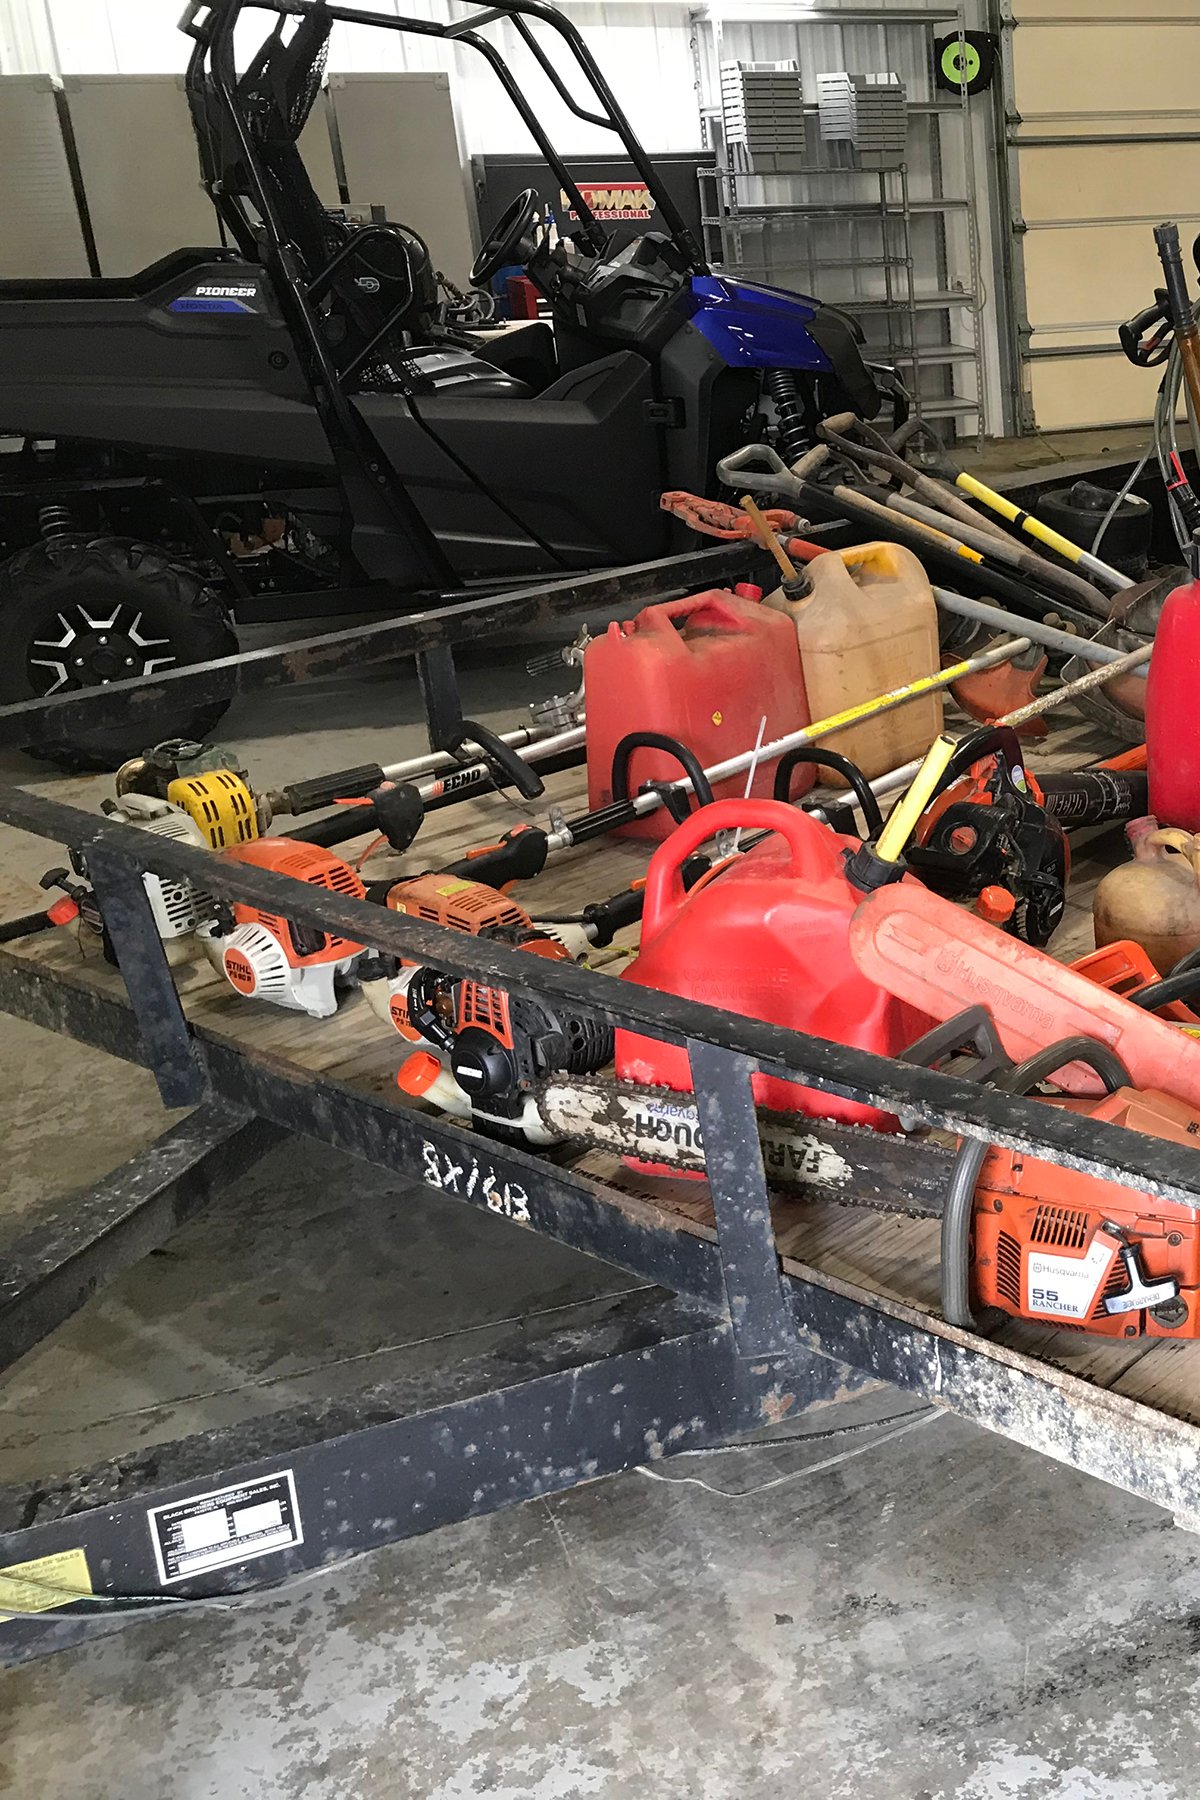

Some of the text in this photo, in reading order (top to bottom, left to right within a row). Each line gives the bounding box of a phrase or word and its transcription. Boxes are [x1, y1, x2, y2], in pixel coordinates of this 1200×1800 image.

[569, 209, 651, 220] PFESSIONAL
[196, 286, 256, 297] PIONEER
[443, 769, 481, 793] ECHO
[226, 960, 252, 975] STIHL
[955, 958, 1055, 1030] Husqvarna
[1186, 1121, 1199, 1134] 55
[635, 1113, 820, 1174] FAR OUGH
[1043, 1264, 1089, 1280] Husqvarna
[1032, 1288, 1059, 1302] 55
[1032, 1299, 1078, 1313] RANCHER
[163, 1510, 183, 1521] BLACK
[216, 1492, 249, 1506] EQUIPMENT
